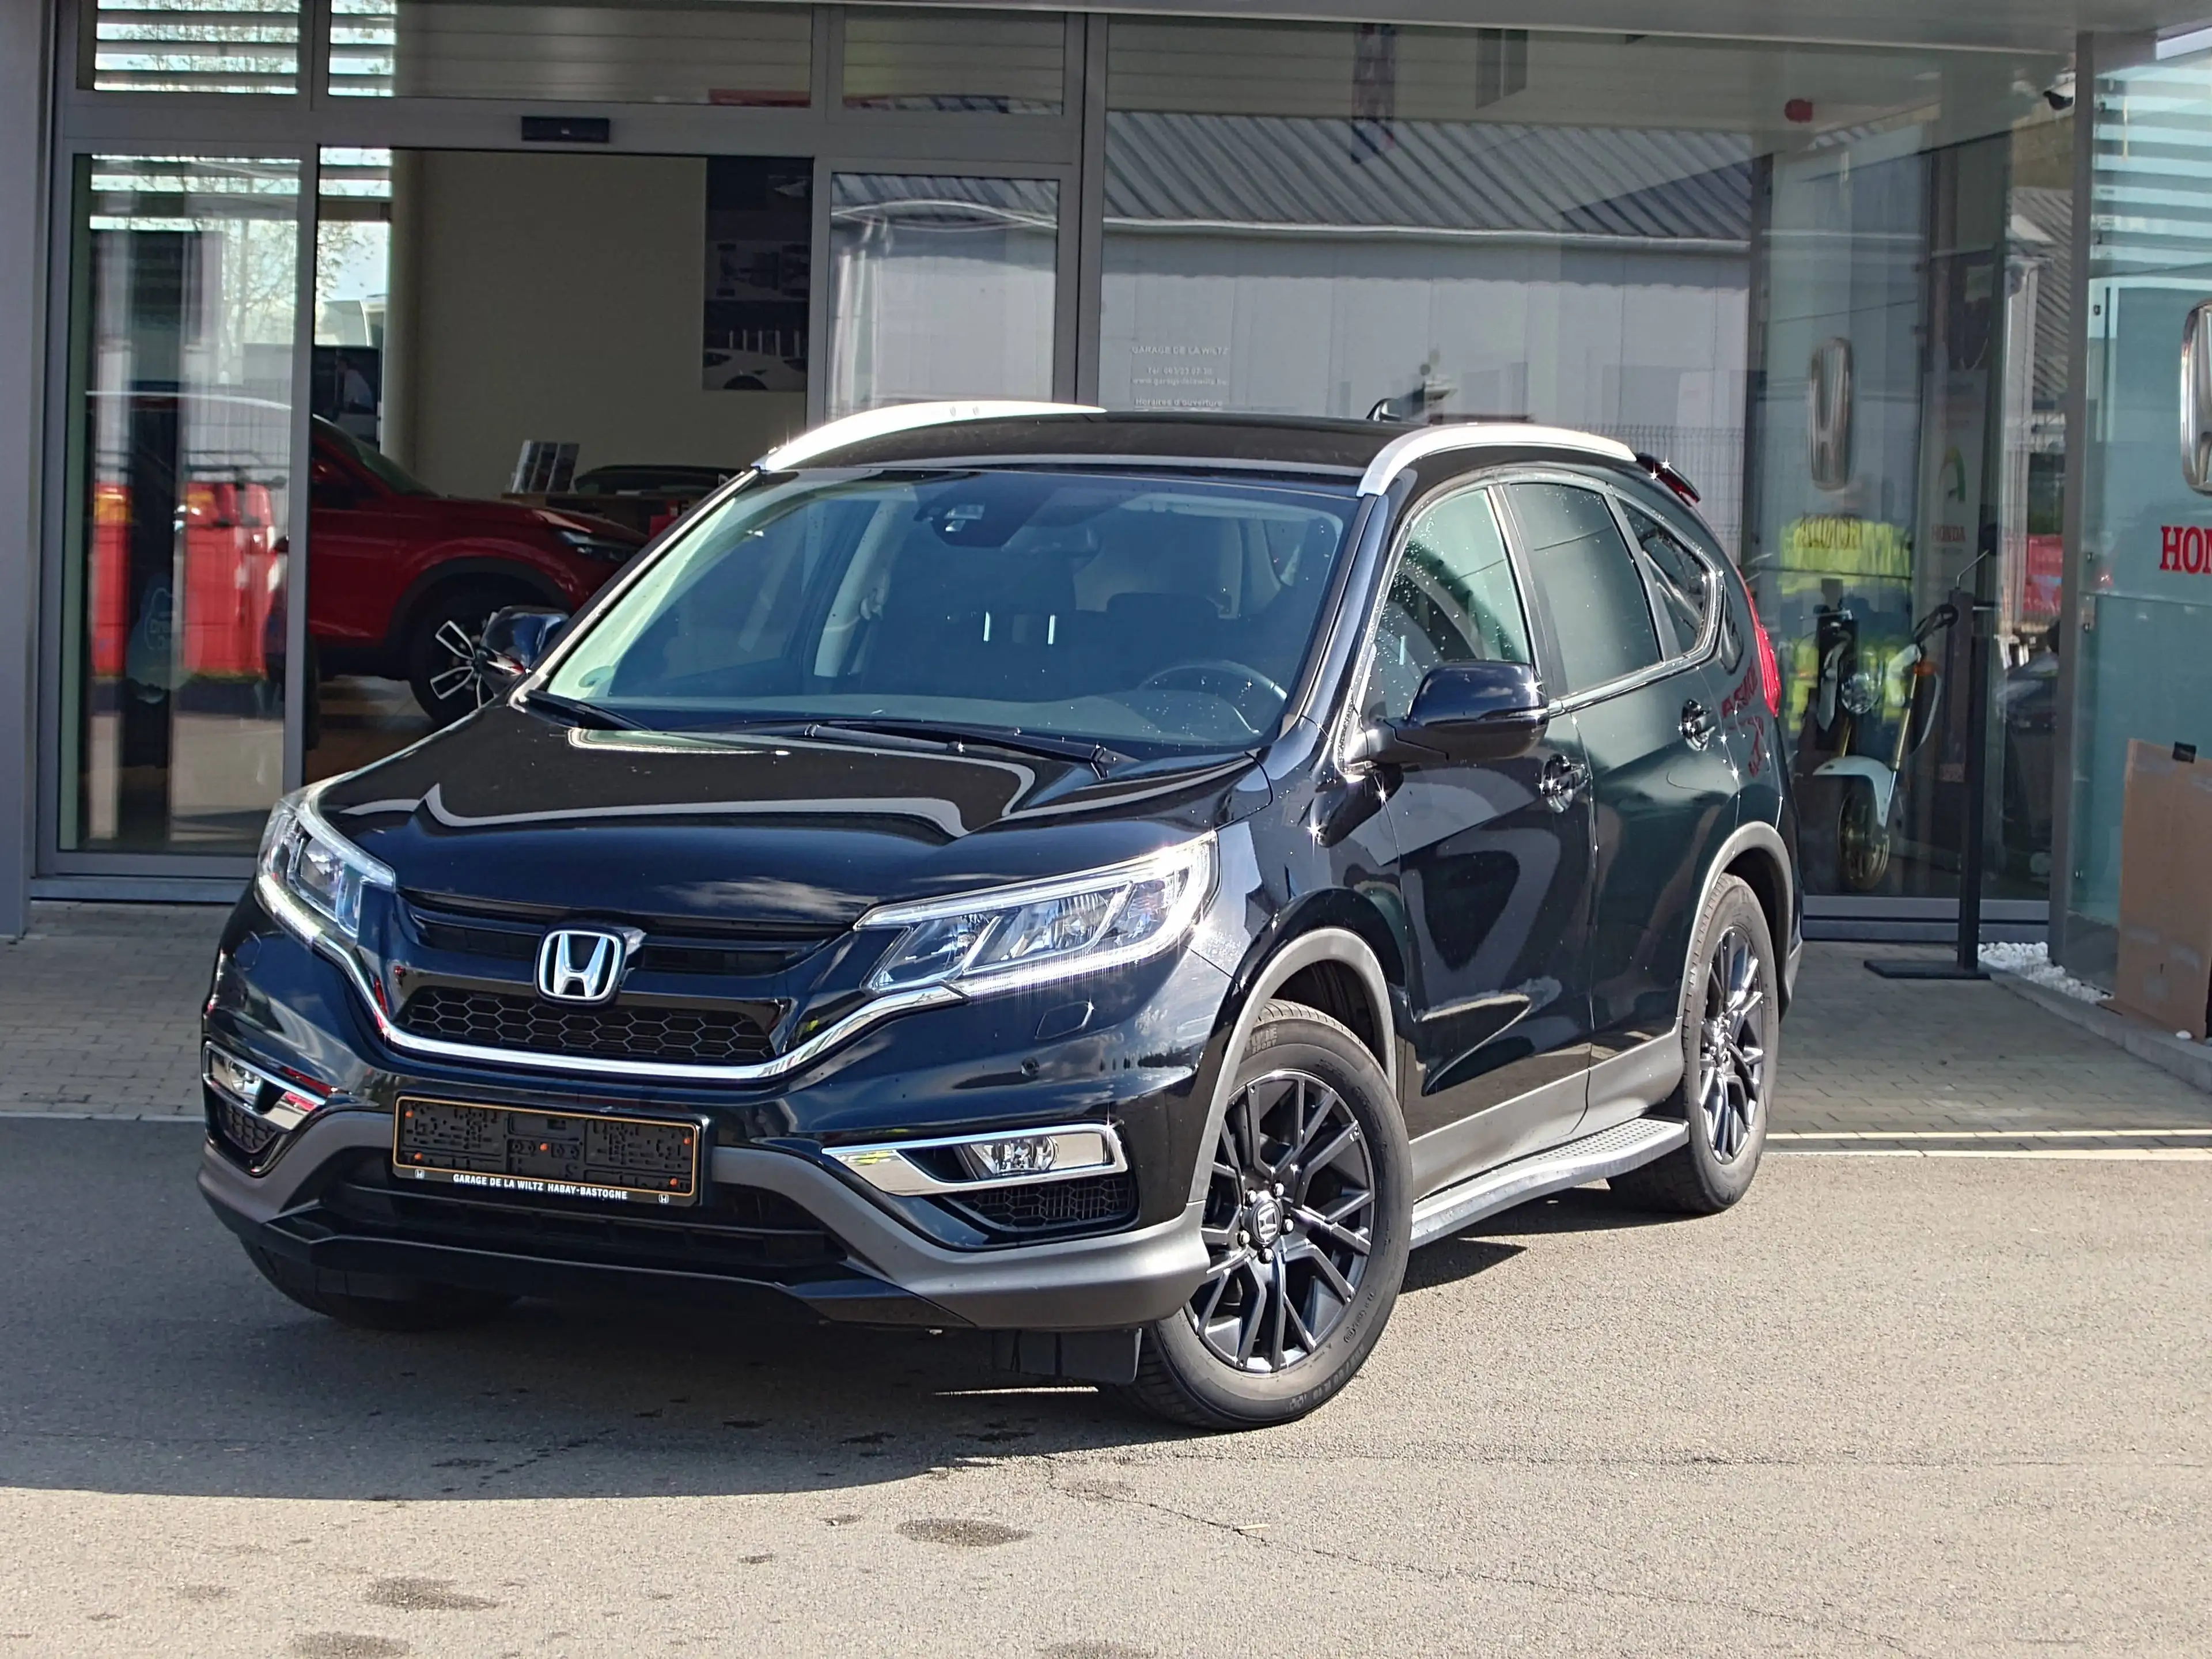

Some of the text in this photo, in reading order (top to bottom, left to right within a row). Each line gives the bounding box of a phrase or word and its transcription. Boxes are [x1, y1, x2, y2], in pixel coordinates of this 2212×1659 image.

[1188, 346, 1200, 355] LA
[453, 1173, 487, 1185] GARAGE
[490, 1175, 501, 1187] DE
[504, 1177, 514, 1188] LA
[517, 1178, 544, 1192] WILTZ
